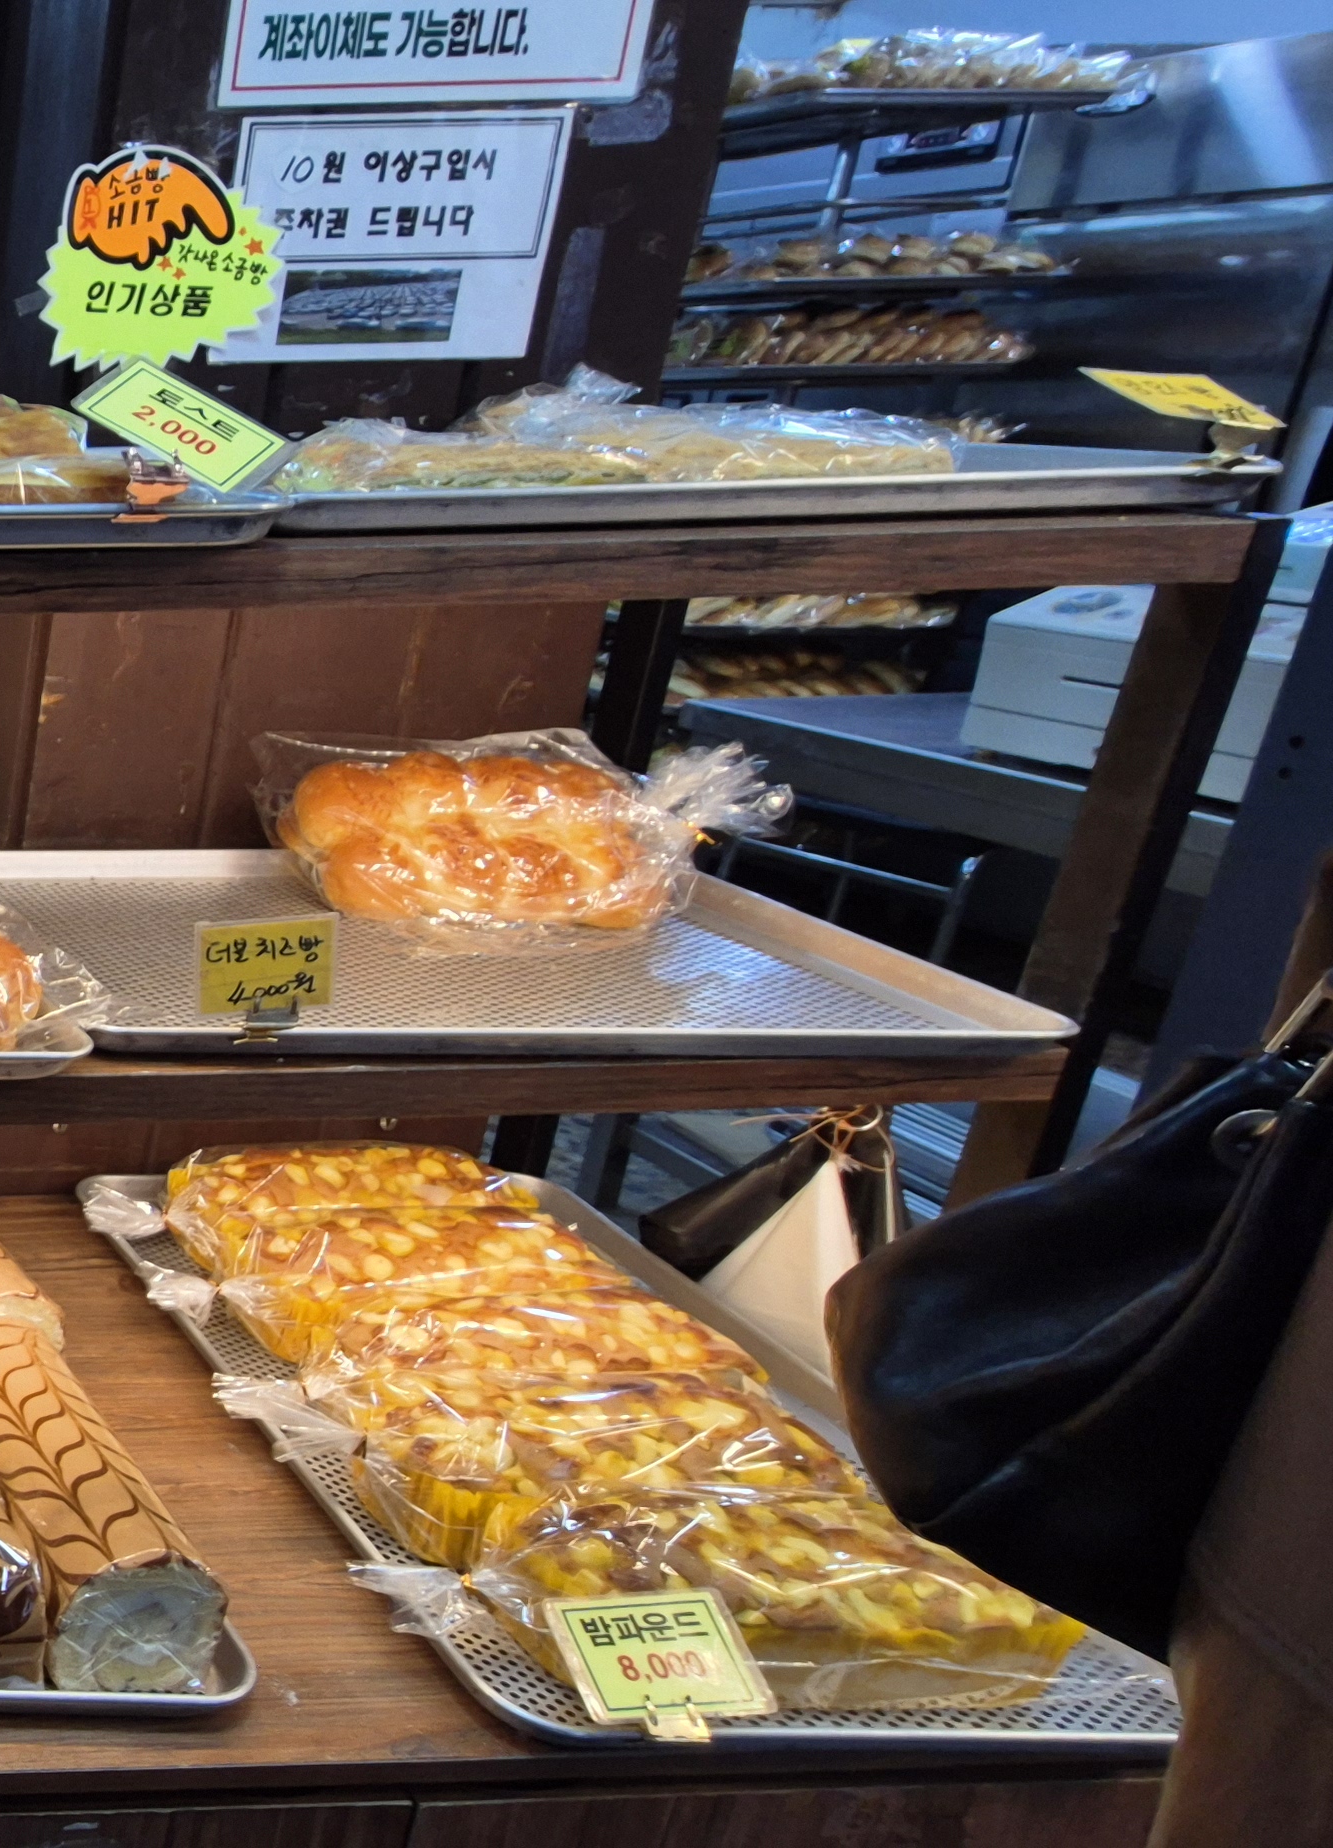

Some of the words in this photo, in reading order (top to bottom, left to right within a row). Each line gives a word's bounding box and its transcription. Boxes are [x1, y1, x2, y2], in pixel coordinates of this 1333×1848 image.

[258, 10, 392, 62] 계좌이체도
[395, 7, 529, 59] 가능합니다.
[363, 147, 498, 183] 이상구입시
[107, 198, 160, 230] HIT
[366, 204, 476, 238] 드립니다
[84, 280, 214, 318] 인기상품
[131, 404, 217, 456] 2,000
[148, 387, 240, 443] 토스트
[579, 1610, 710, 1648] 밤파운드
[617, 1650, 707, 1684] 8,000
